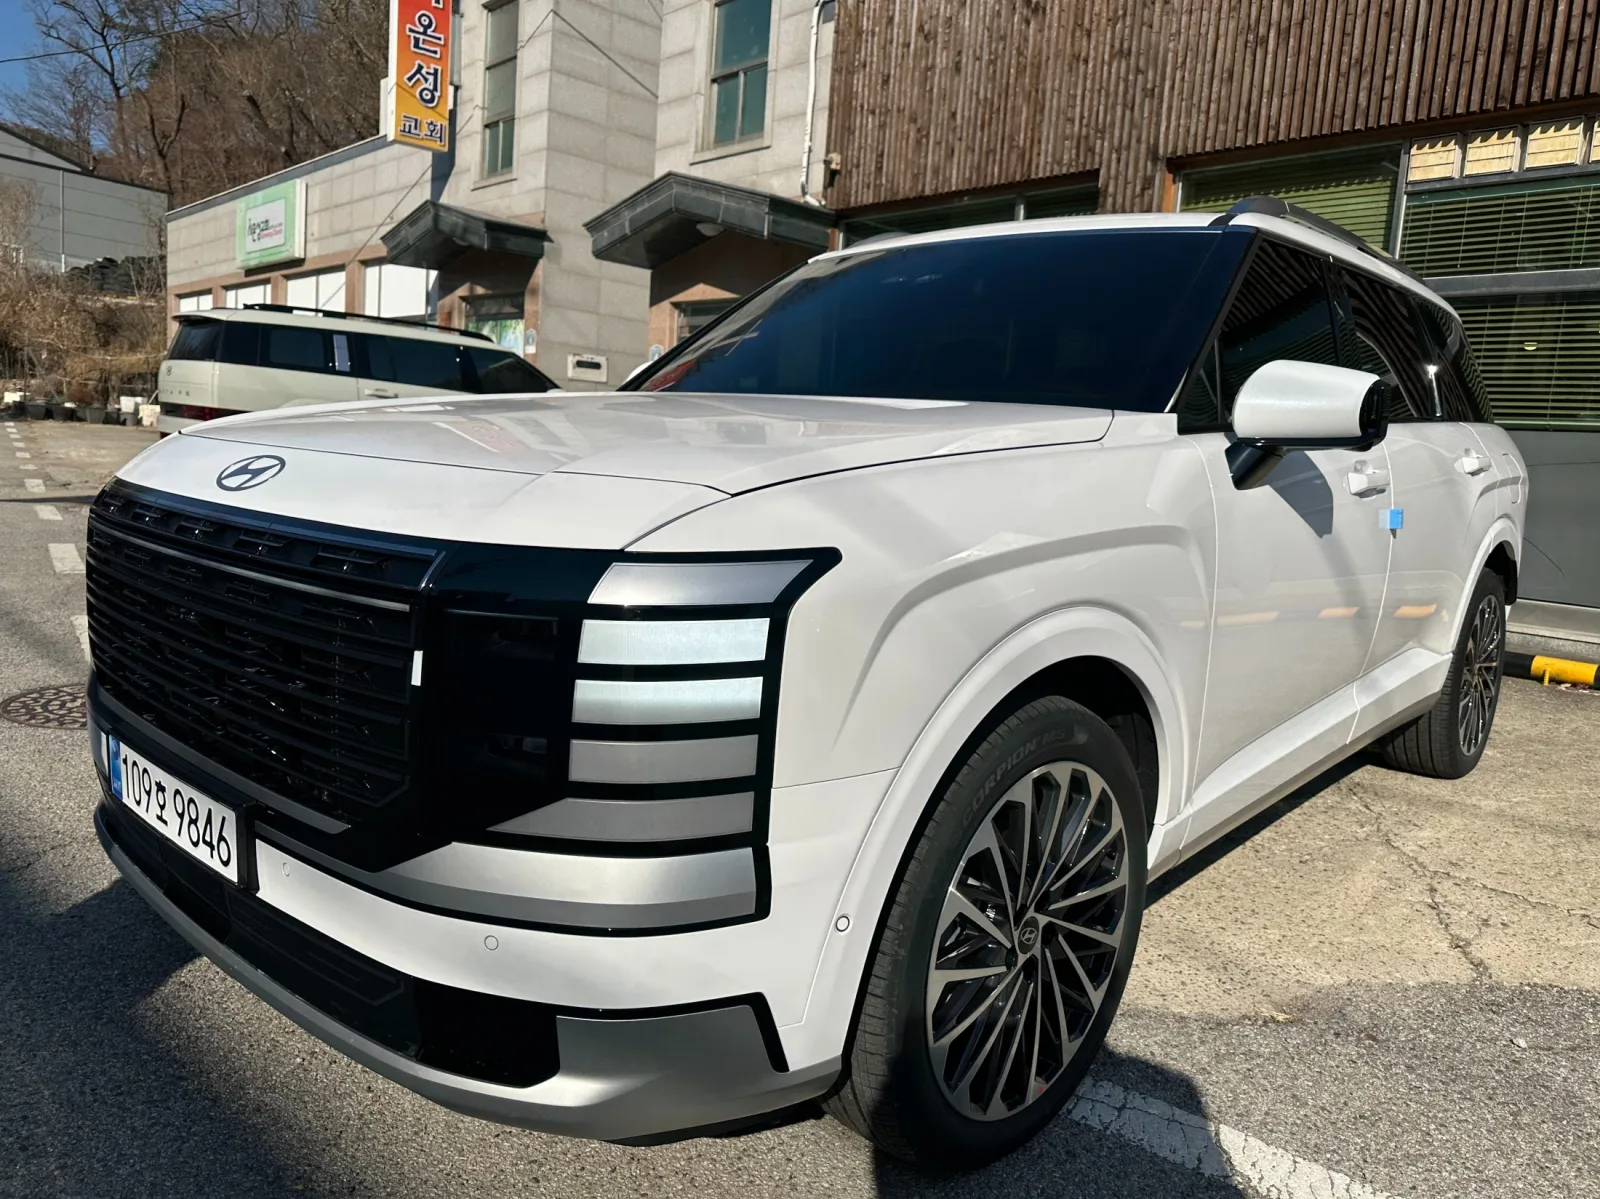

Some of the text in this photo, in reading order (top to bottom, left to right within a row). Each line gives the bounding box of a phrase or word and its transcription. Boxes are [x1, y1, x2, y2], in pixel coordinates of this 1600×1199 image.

[404, 0, 444, 107] 온성
[399, 114, 446, 145] 교회
[173, 788, 231, 868] 9846
[955, 738, 1037, 840] CORPION
